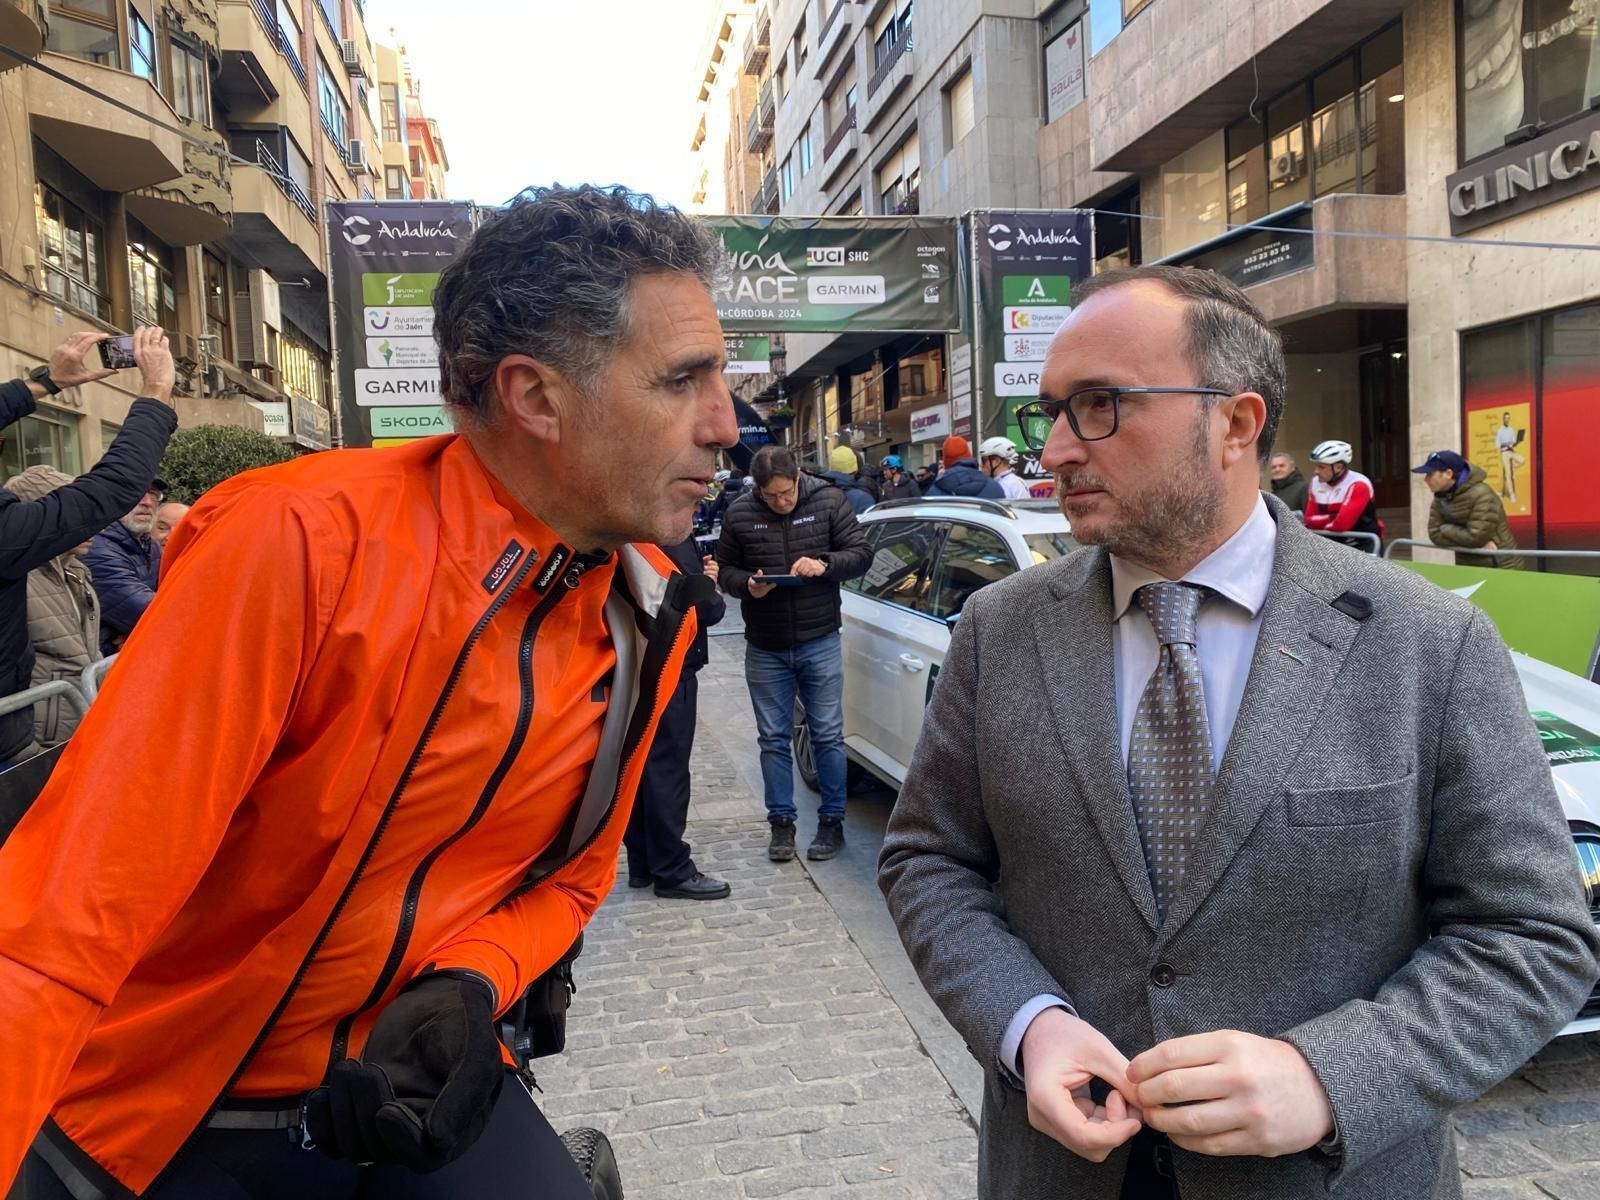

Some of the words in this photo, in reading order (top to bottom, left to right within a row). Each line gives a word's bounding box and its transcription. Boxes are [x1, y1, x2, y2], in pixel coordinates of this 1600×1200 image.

[377, 220, 458, 239] Andalucía
[1016, 228, 1082, 245] Andalucía
[813, 251, 841, 262] UCI
[848, 251, 869, 262] SHC
[713, 275, 799, 304] RACE
[816, 284, 877, 295] GARMIN
[778, 308, 802, 318] 2024
[365, 380, 440, 394] GARMI
